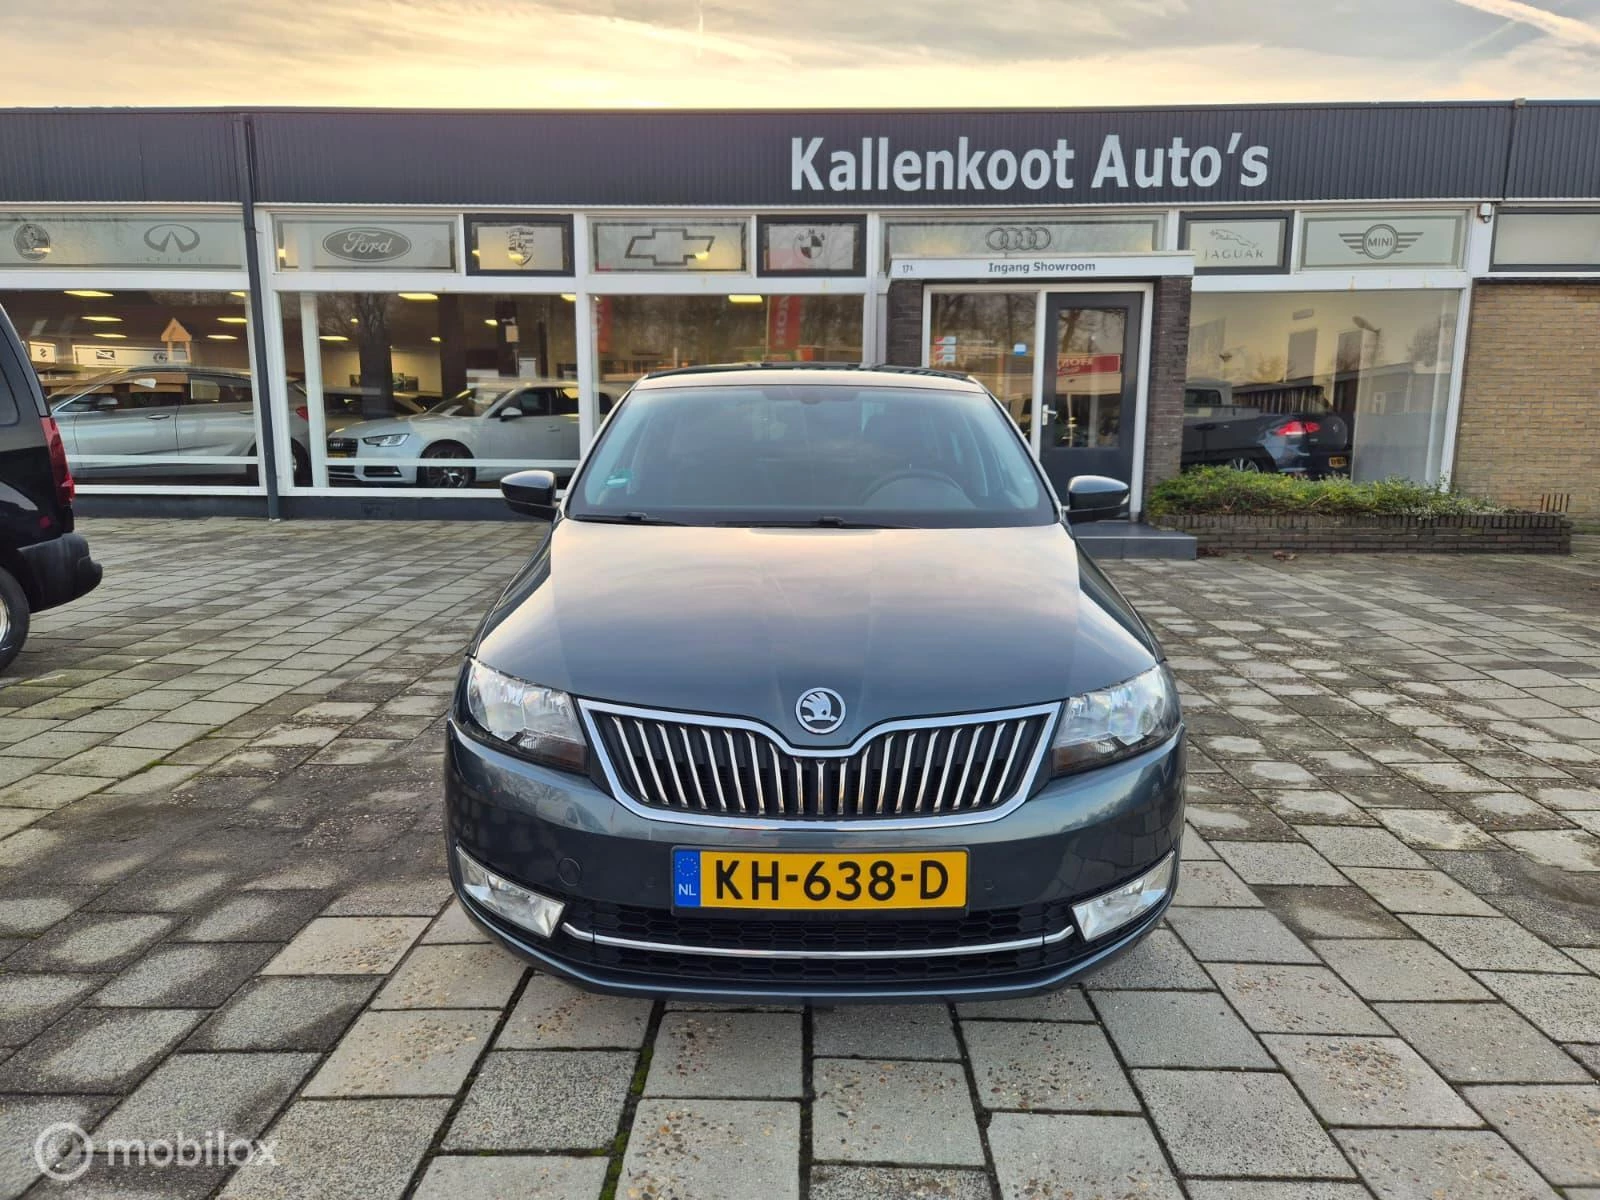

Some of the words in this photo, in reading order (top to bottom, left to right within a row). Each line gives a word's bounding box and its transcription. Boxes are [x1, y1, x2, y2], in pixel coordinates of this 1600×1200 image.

[791, 137, 1074, 192] Kallenkoot
[1091, 133, 1269, 189] Auto's
[341, 232, 394, 254] Ford
[1367, 237, 1394, 248] MINI
[1204, 248, 1265, 261] JAGUAR
[988, 262, 1031, 274] Ingang
[1034, 260, 1096, 273] Showroom
[715, 860, 949, 902] KH-638-D
[678, 883, 697, 896] NL
